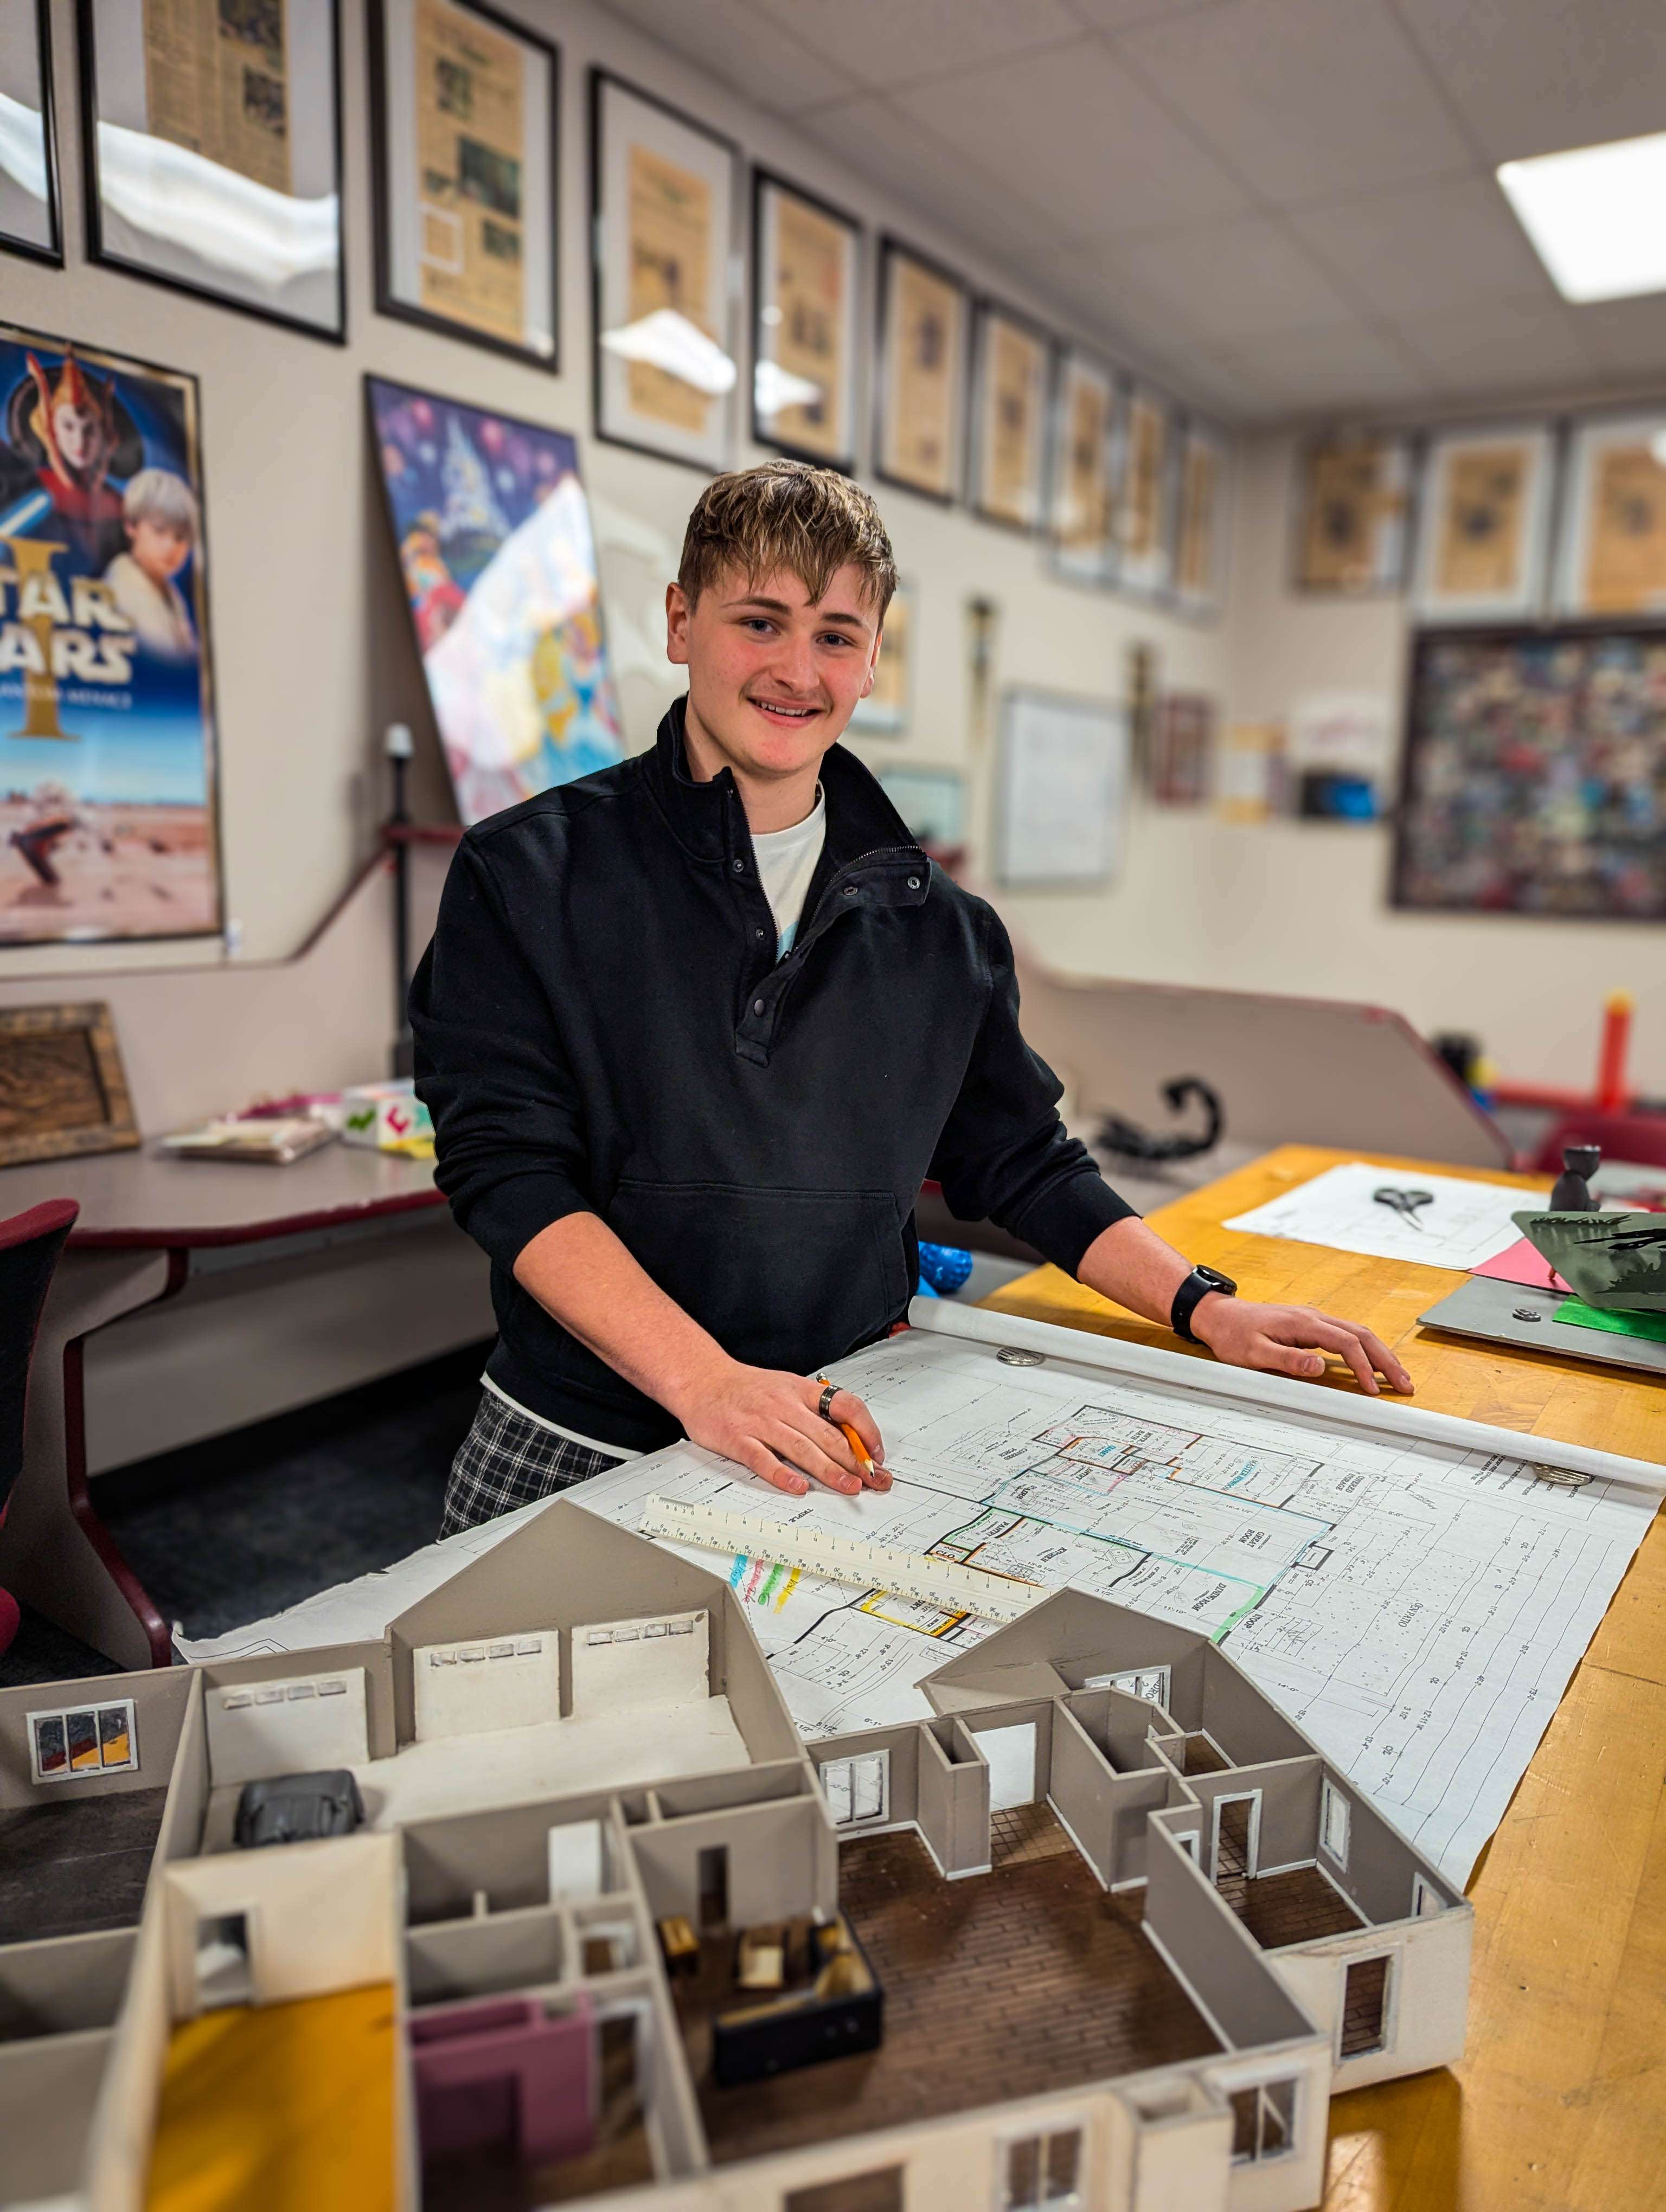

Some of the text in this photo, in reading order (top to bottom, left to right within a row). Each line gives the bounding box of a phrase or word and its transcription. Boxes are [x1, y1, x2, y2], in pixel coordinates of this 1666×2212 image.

[1098, 1445, 1116, 1457] CLOSET
[1241, 1459, 1259, 1477] MASTER
[1335, 1473, 1356, 1491] STORAGE
[1345, 1476, 1364, 1493] COVERED
[1238, 1529, 1255, 1544] ROOM
[1247, 1532, 1265, 1549] GREAT
[935, 1549, 955, 1560] CLO.
[1041, 1547, 1067, 1562] KITCHEN
[1208, 1582, 1227, 1600] DINING
[1191, 1598, 1209, 1611] ROOM
[1244, 1613, 1263, 1629] STOOP
[1398, 1611, 1413, 1628] PATIO
[1277, 1682, 1299, 1693] 14'-0"
[1382, 1745, 1393, 1756] C/L
